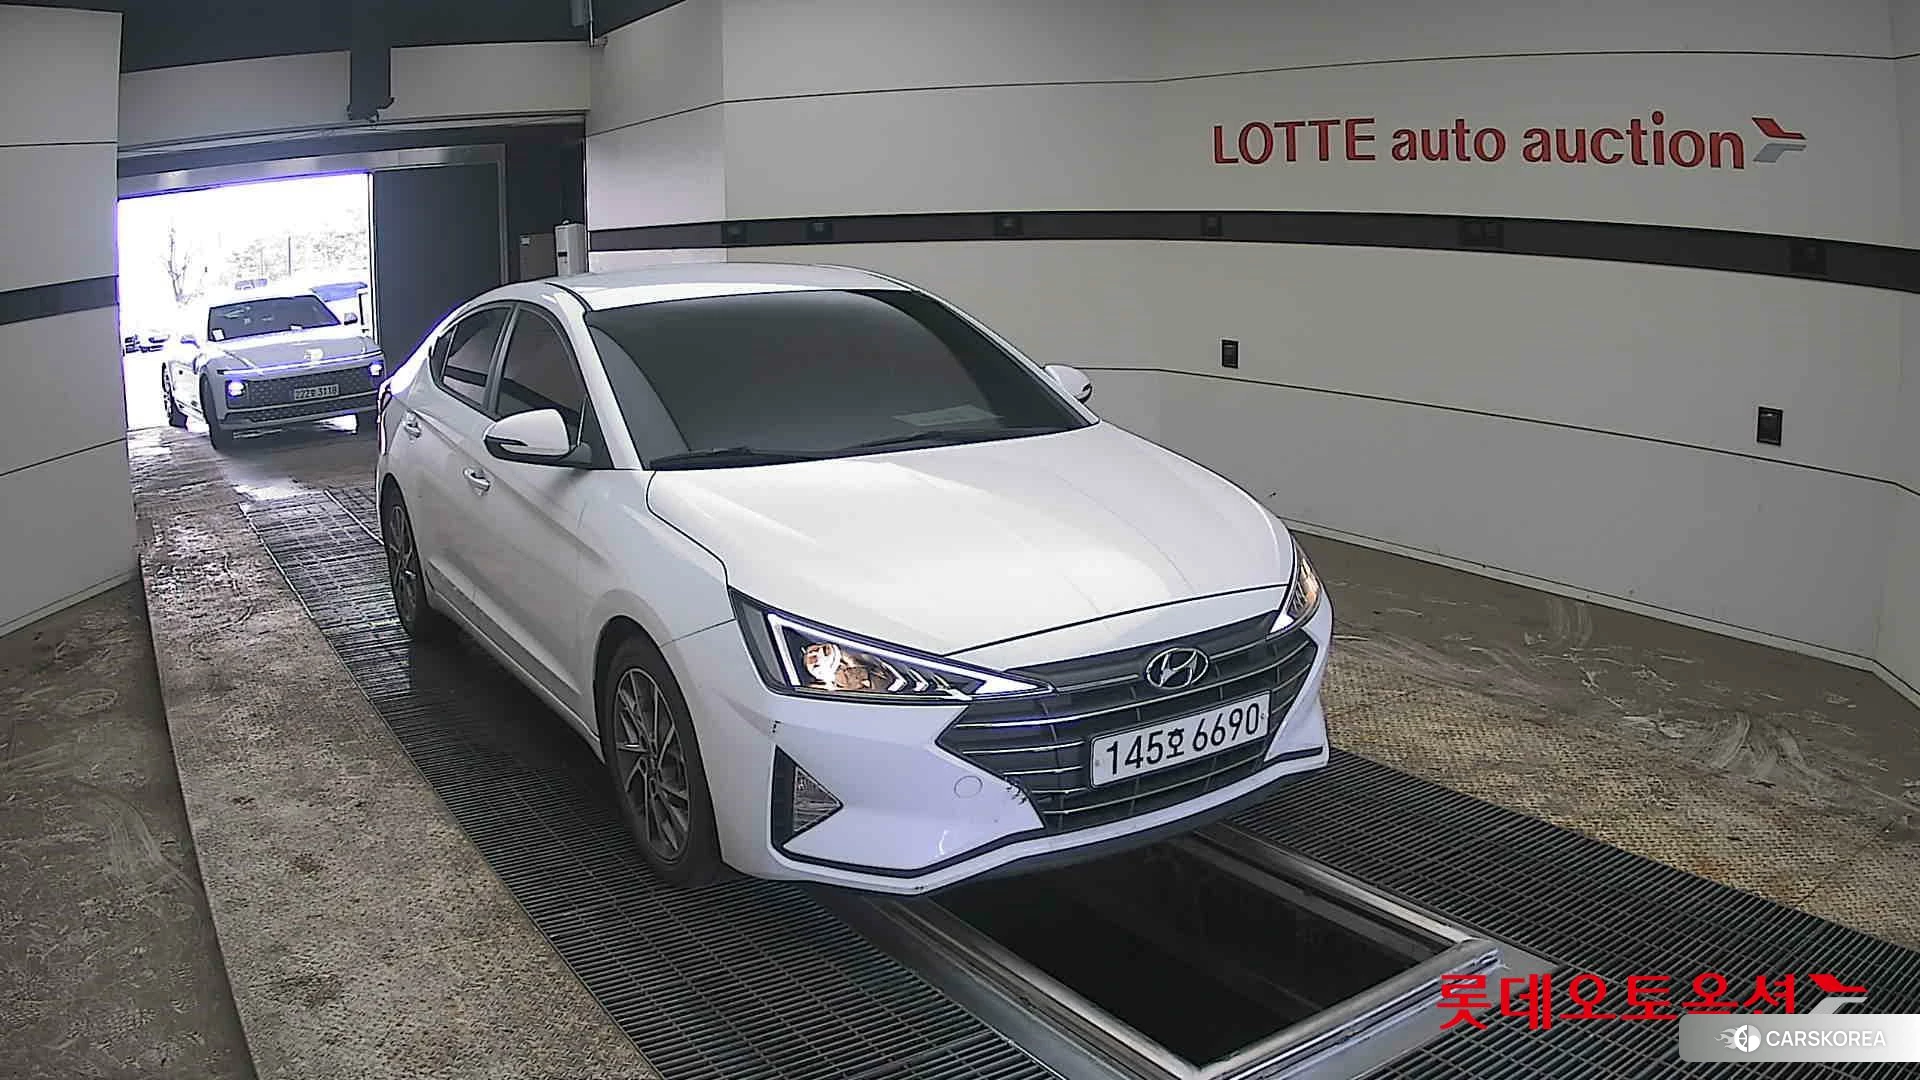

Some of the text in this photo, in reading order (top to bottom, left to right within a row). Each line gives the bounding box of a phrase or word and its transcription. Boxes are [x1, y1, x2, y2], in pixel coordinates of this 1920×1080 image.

[1212, 110, 1746, 170] LOTTE auto auction
[1106, 702, 1260, 776] 145호 6690
